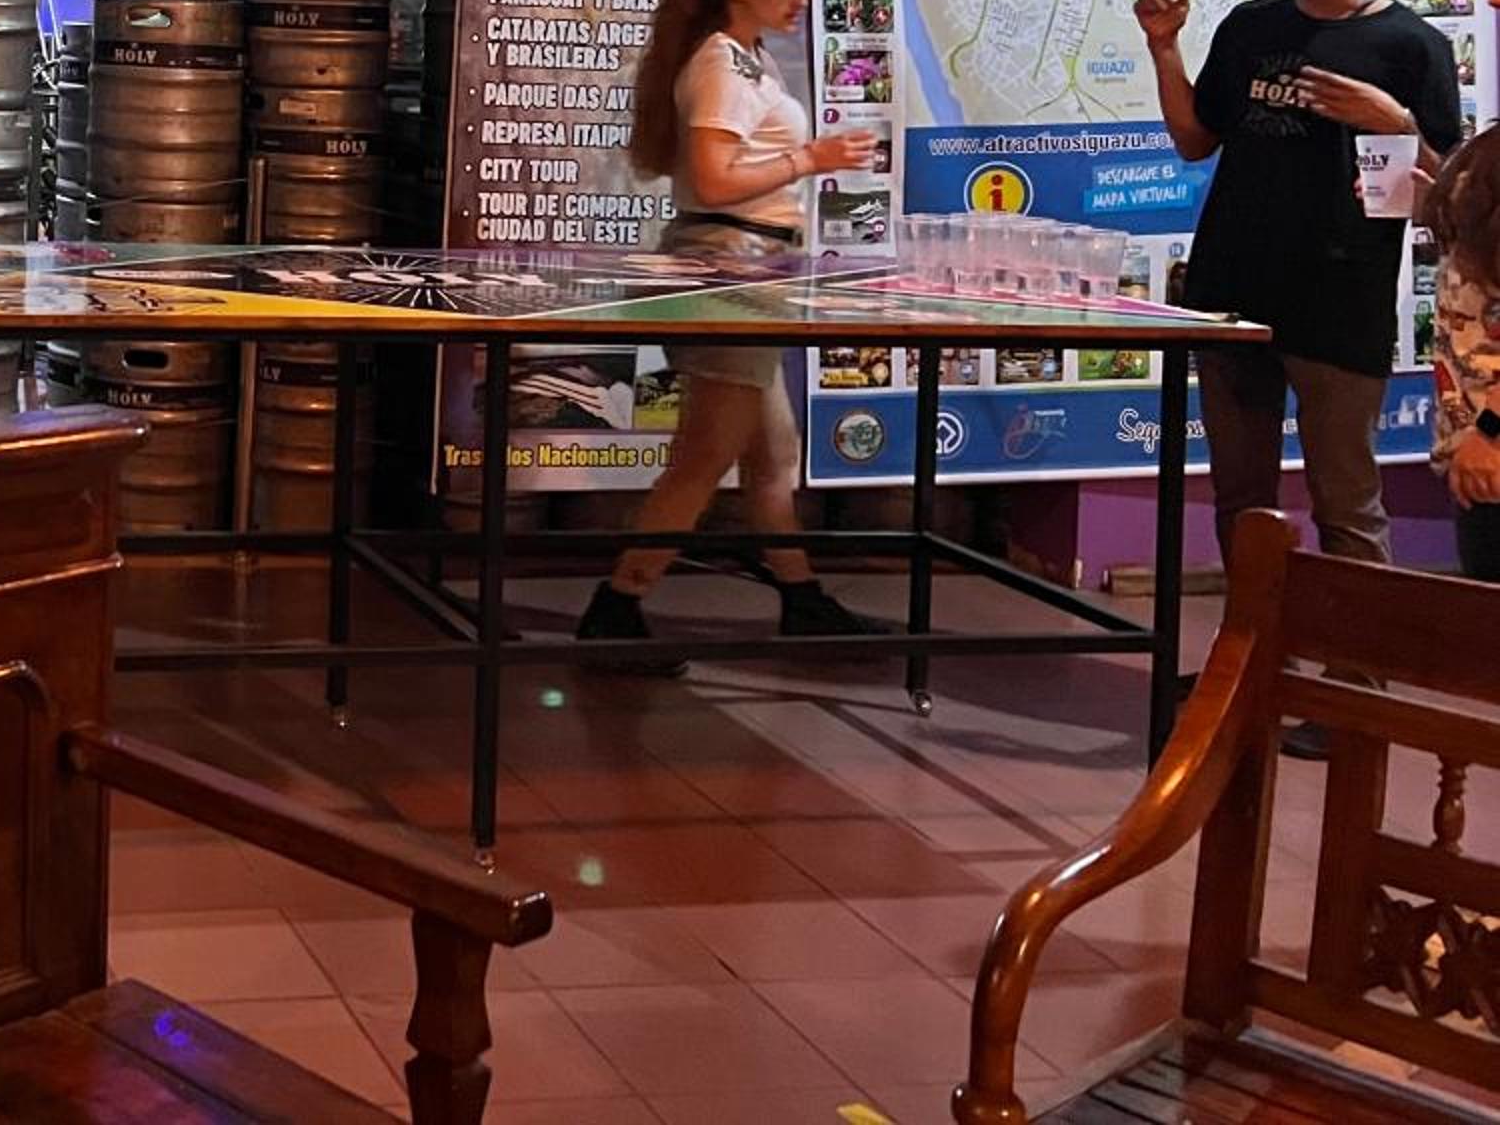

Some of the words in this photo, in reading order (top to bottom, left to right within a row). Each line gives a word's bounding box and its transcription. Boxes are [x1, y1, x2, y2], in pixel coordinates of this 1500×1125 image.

[274, 9, 319, 28] HOLY
[487, 18, 592, 45] CATARATAS
[115, 47, 157, 65] HOLY
[487, 43, 500, 66] Y
[505, 44, 621, 71] BRASILERAS
[483, 82, 557, 111] PARQUE
[563, 85, 600, 111] DAS
[326, 138, 368, 155] HOLY
[481, 121, 567, 147] REPRESA
[930, 131, 1175, 156] www.atractivosiguazu.co
[479, 158, 522, 182] CITY
[529, 160, 580, 184] TOUR
[478, 192, 528, 217] TOUR
[533, 194, 559, 217] DE
[564, 195, 656, 221] COMPRAS
[476, 218, 546, 243] CIUDAD
[552, 219, 587, 244] DEL
[594, 220, 640, 245] ESTE
[538, 442, 638, 467] Nacionales
[642, 450, 655, 467] e
